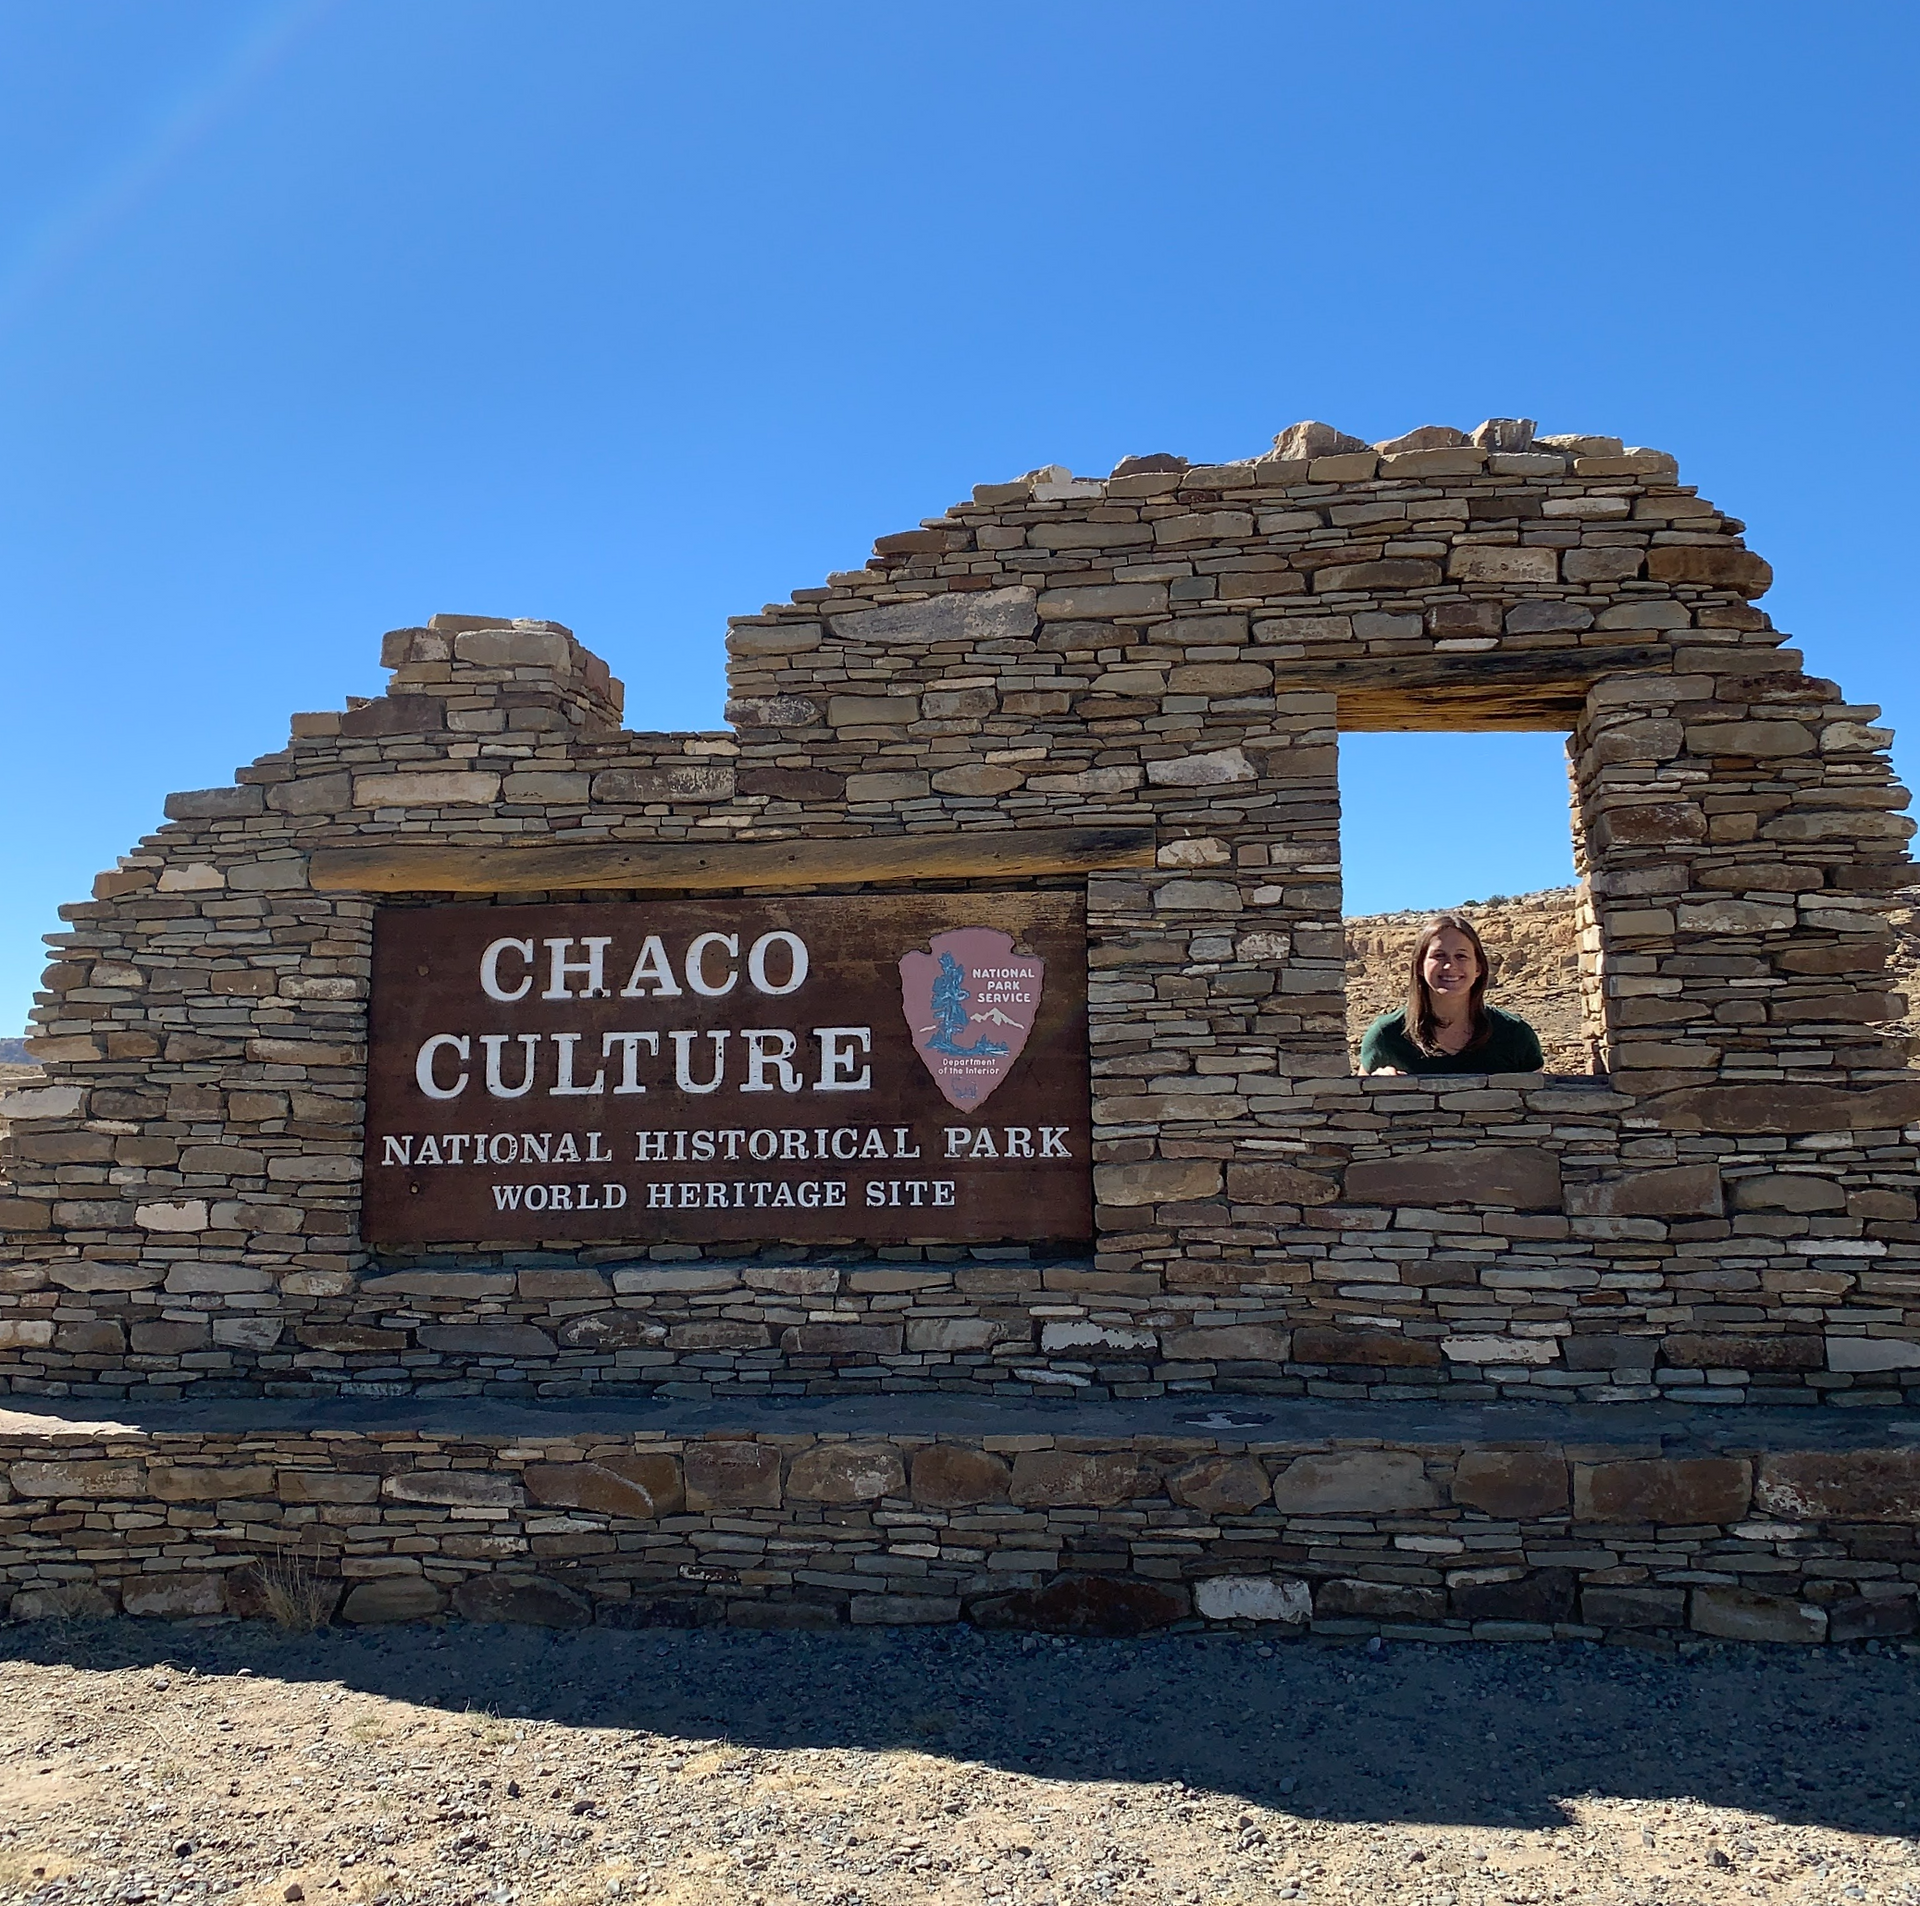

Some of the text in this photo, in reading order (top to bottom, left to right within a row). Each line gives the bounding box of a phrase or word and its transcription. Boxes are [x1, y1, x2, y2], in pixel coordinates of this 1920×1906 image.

[479, 930, 809, 1002] CHACO
[972, 968, 1035, 979] NATIONAL
[987, 980, 1020, 991] PARK
[977, 992, 1031, 1003] SERVICE
[415, 1026, 871, 1100] CULTURE
[942, 1058, 996, 1067] Department
[938, 1067, 1000, 1075] of the Interior
[381, 1126, 1073, 1166] NATIONAL HISTORICAL PARK
[491, 1180, 955, 1211] WORLD HERITAGE SITE
